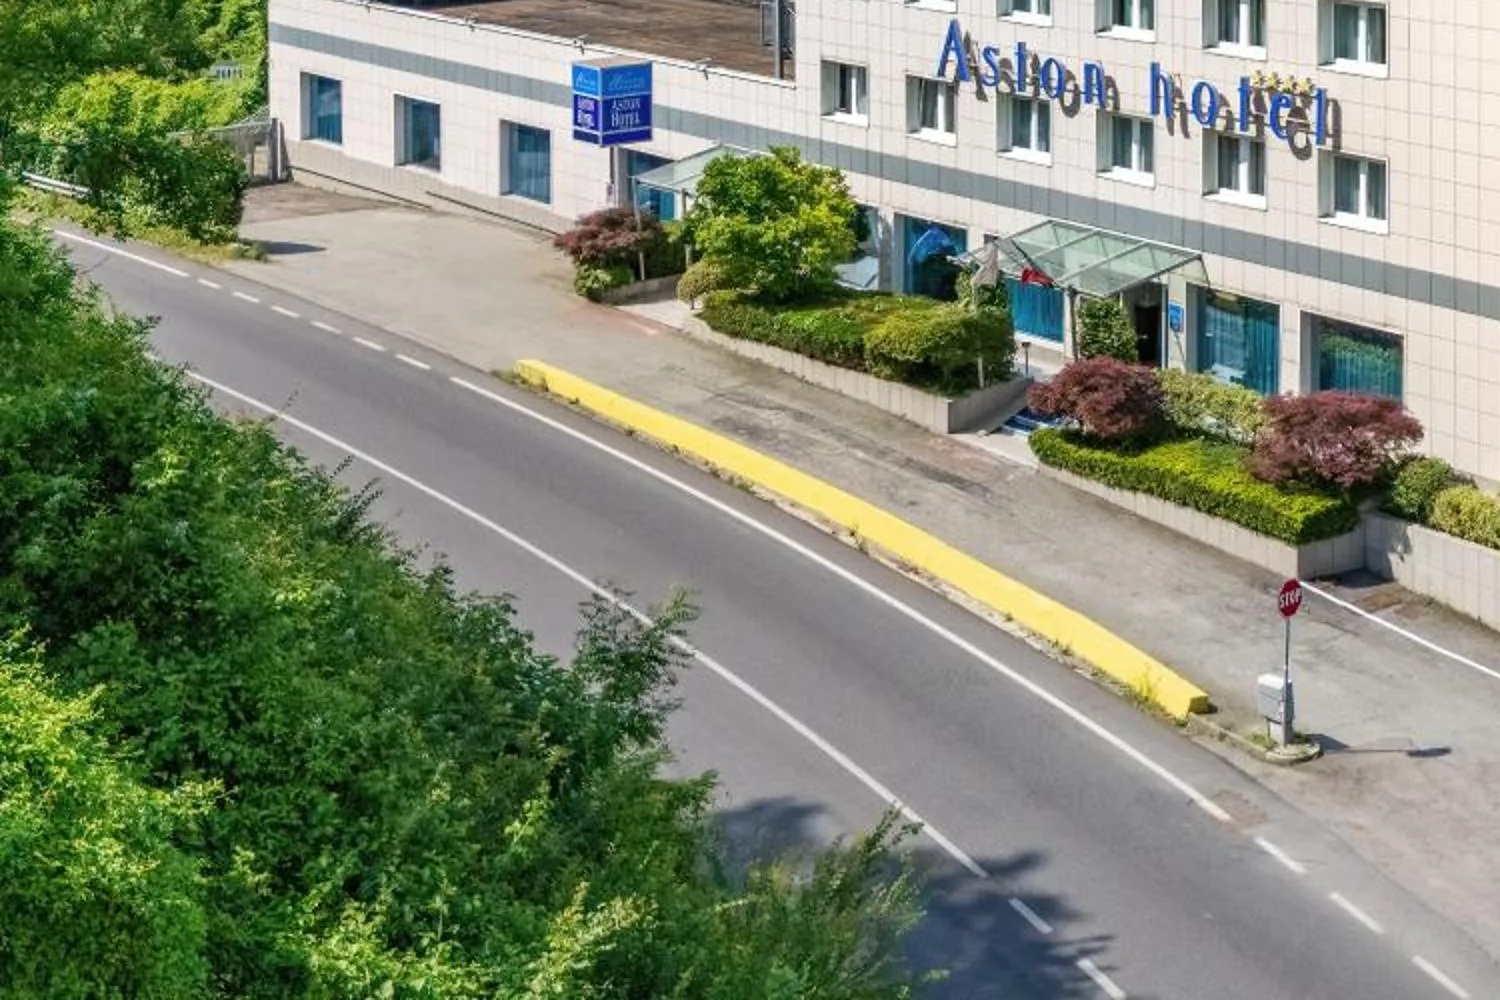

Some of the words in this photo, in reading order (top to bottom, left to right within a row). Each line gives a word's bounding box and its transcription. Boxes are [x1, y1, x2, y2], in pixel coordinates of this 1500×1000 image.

[937, 18, 1106, 109] Aston
[1150, 61, 1328, 147] hotel
[1280, 588, 1302, 609] STOP
